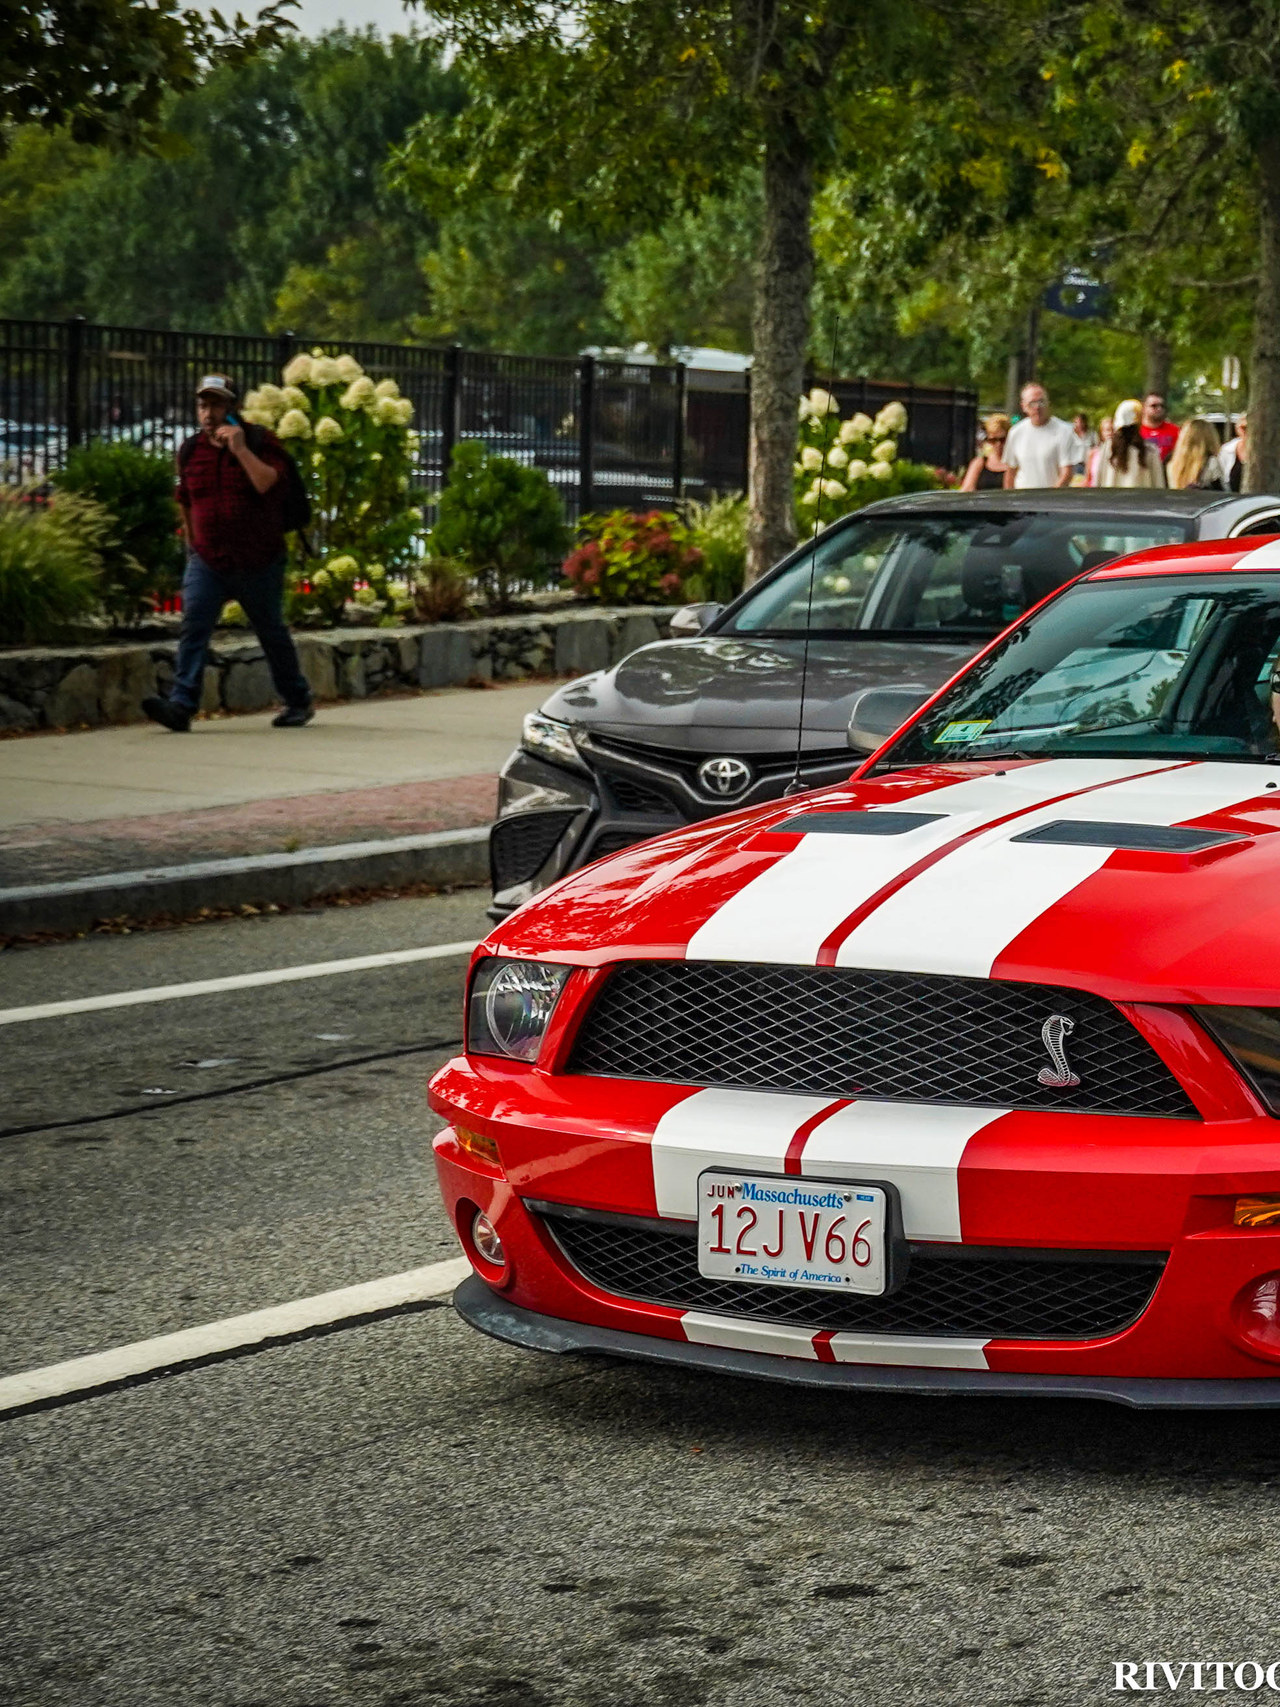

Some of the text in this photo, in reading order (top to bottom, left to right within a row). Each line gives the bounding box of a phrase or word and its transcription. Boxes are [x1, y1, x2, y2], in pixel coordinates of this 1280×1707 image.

[707, 1182, 844, 1209] JUN Massachusetts
[740, 1263, 842, 1283] The Spirit of America
